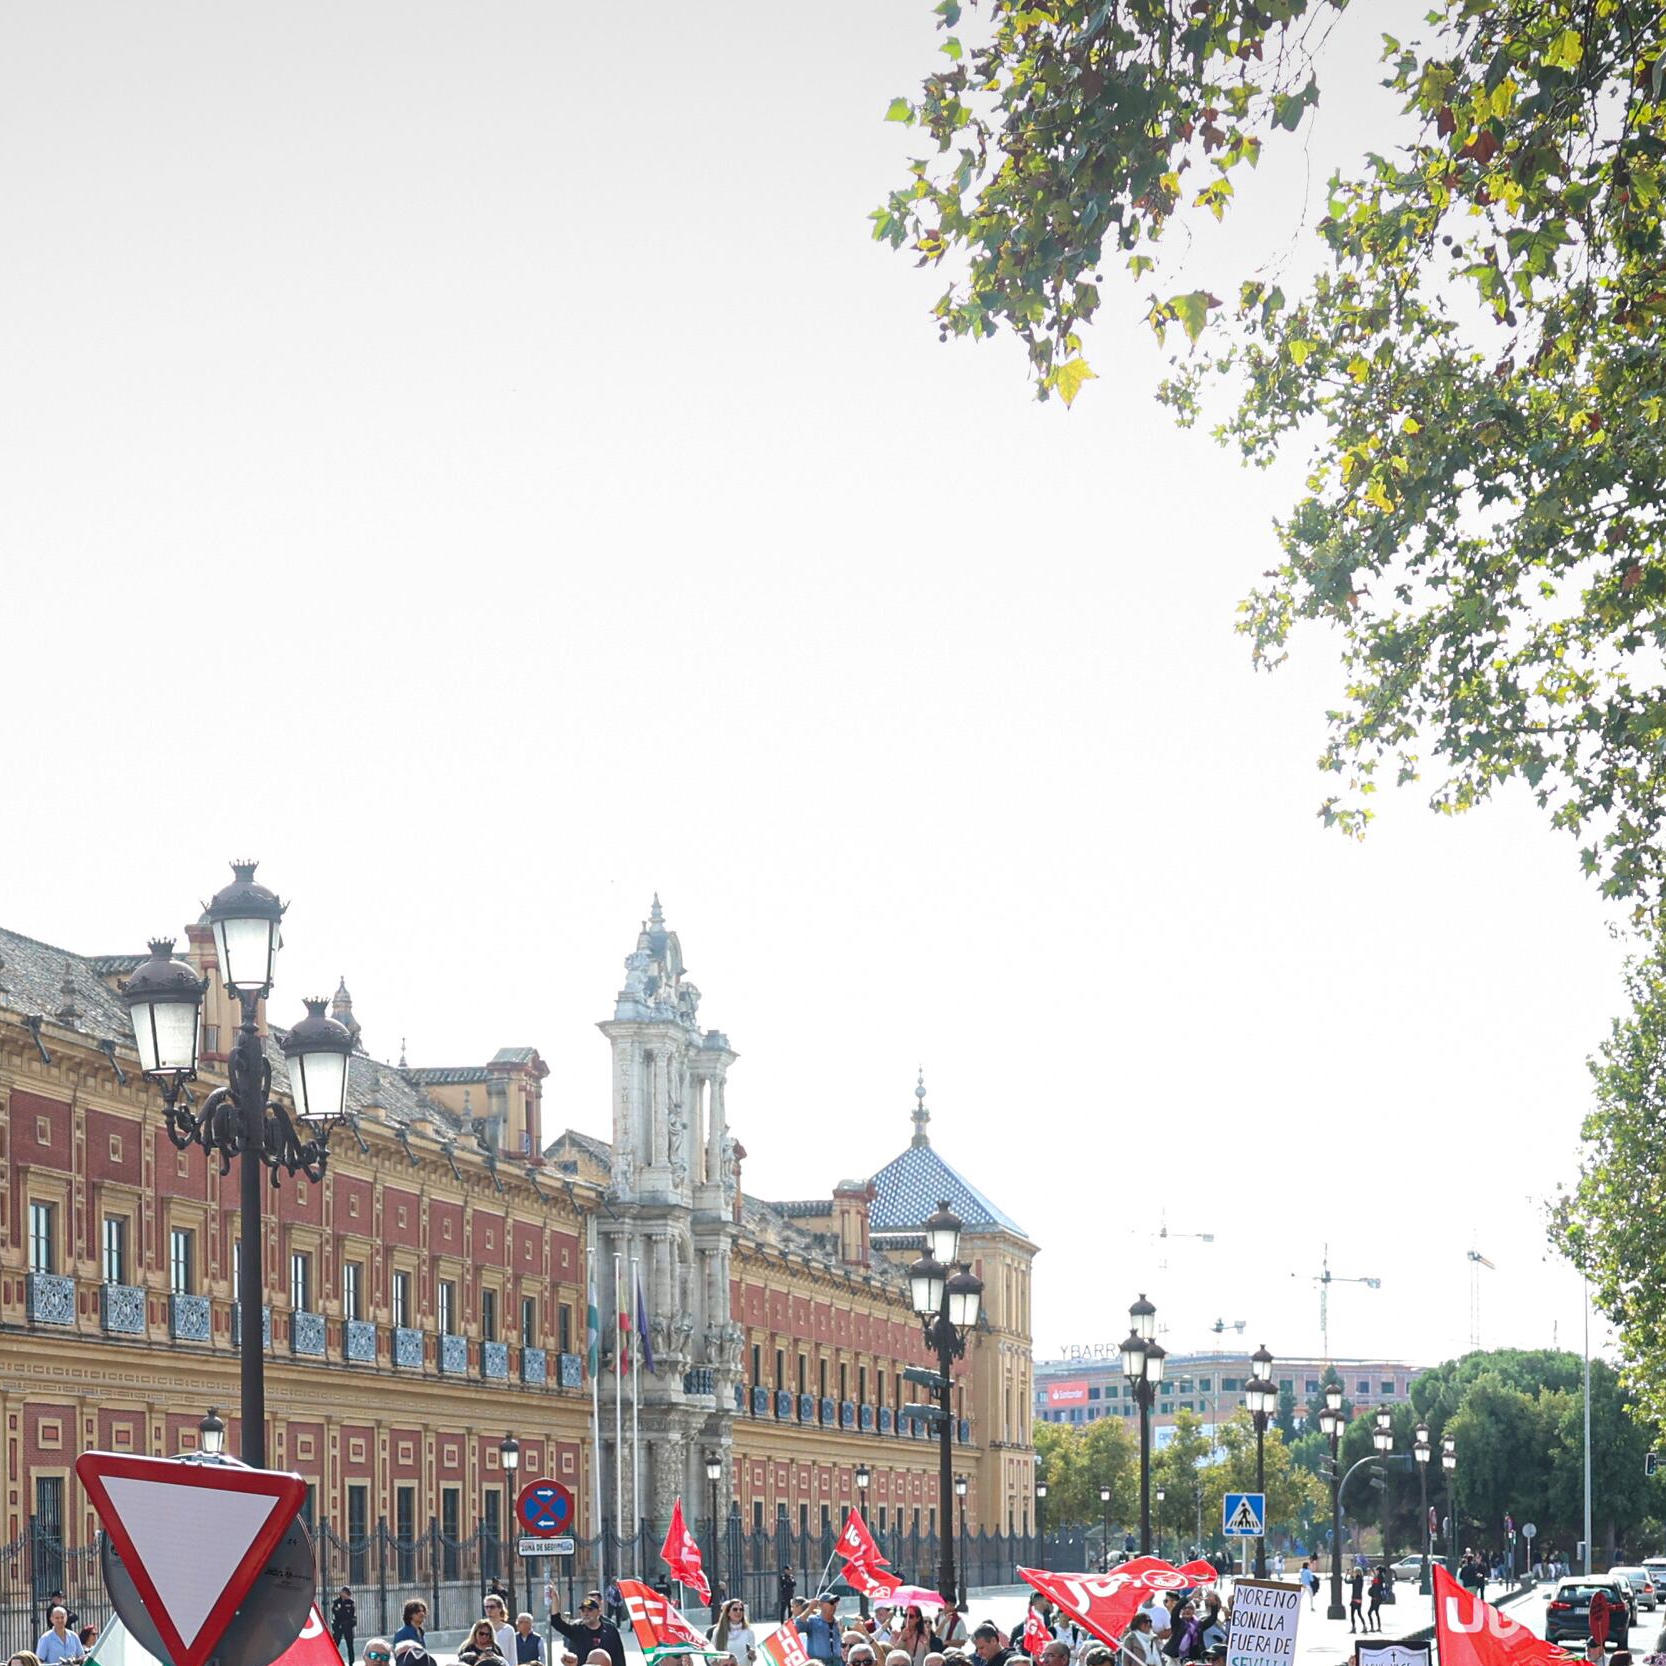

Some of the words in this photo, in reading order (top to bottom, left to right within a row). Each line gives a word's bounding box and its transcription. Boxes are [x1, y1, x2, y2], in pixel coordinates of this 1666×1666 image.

[1060, 1342, 1122, 1360] YBARR
[1234, 1586, 1298, 1610] MORENO
[1233, 1609, 1285, 1632] BONILLA
[1230, 1632, 1271, 1653] FUERA
[1274, 1635, 1294, 1655] DE
